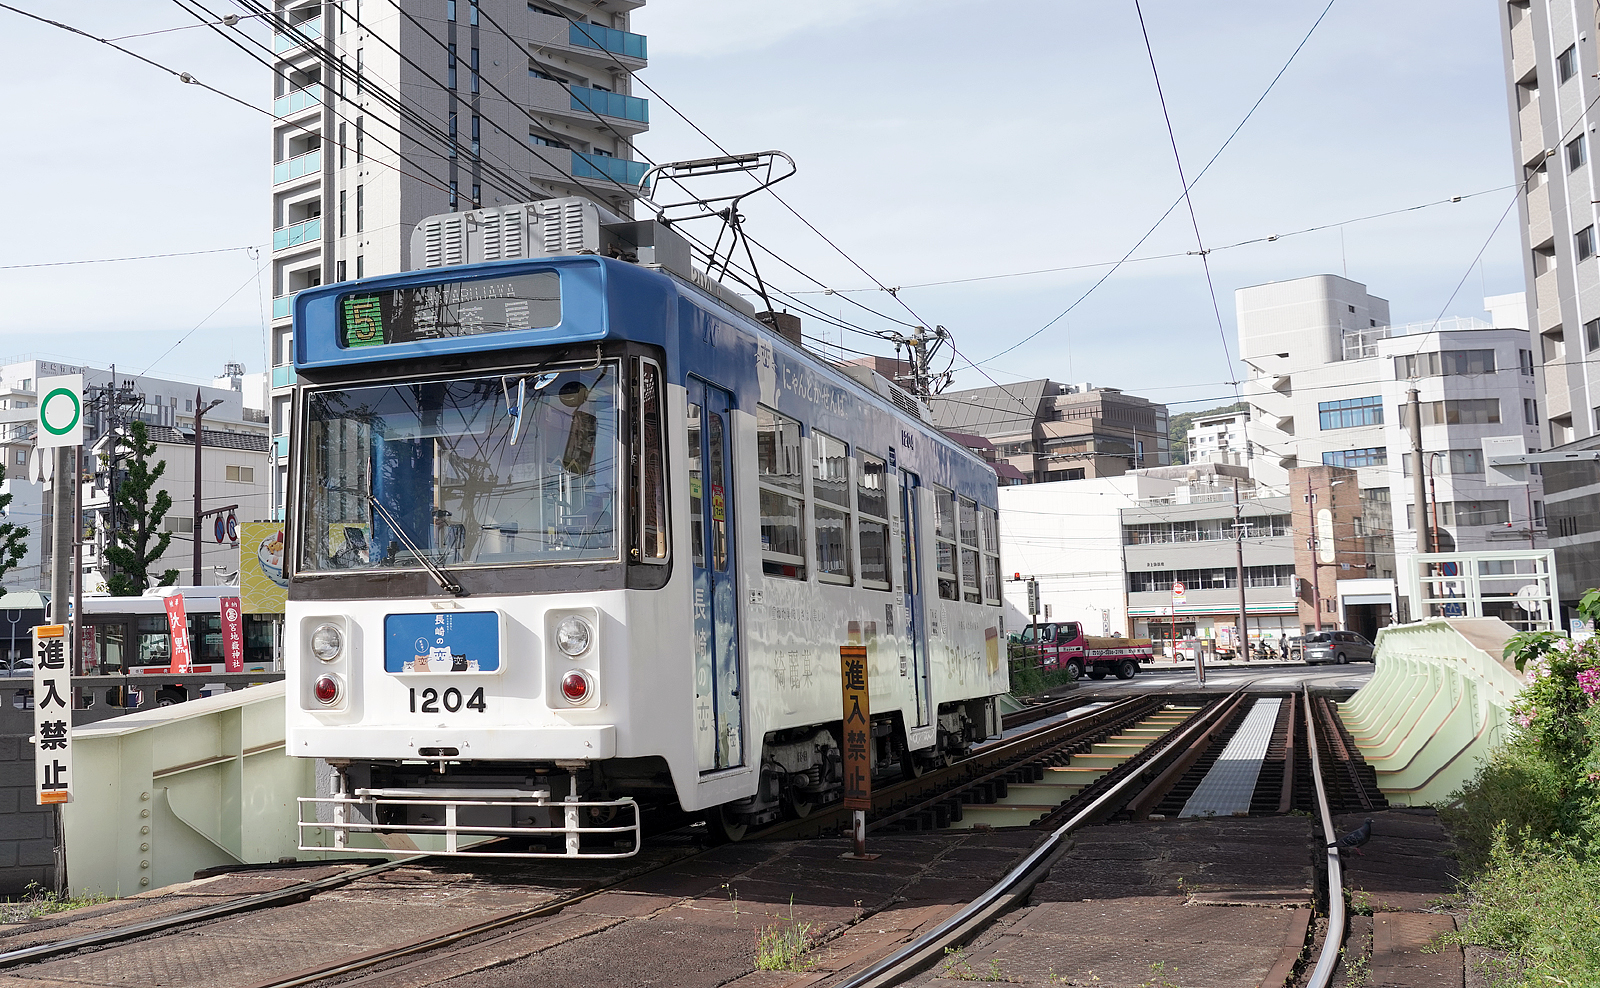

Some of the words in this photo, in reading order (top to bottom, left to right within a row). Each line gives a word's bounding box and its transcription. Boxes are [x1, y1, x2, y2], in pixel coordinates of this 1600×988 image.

[352, 302, 376, 340] 5
[37, 639, 68, 790] 進入禁止
[409, 686, 487, 713] 1204
[845, 659, 867, 797] 進入禁止
